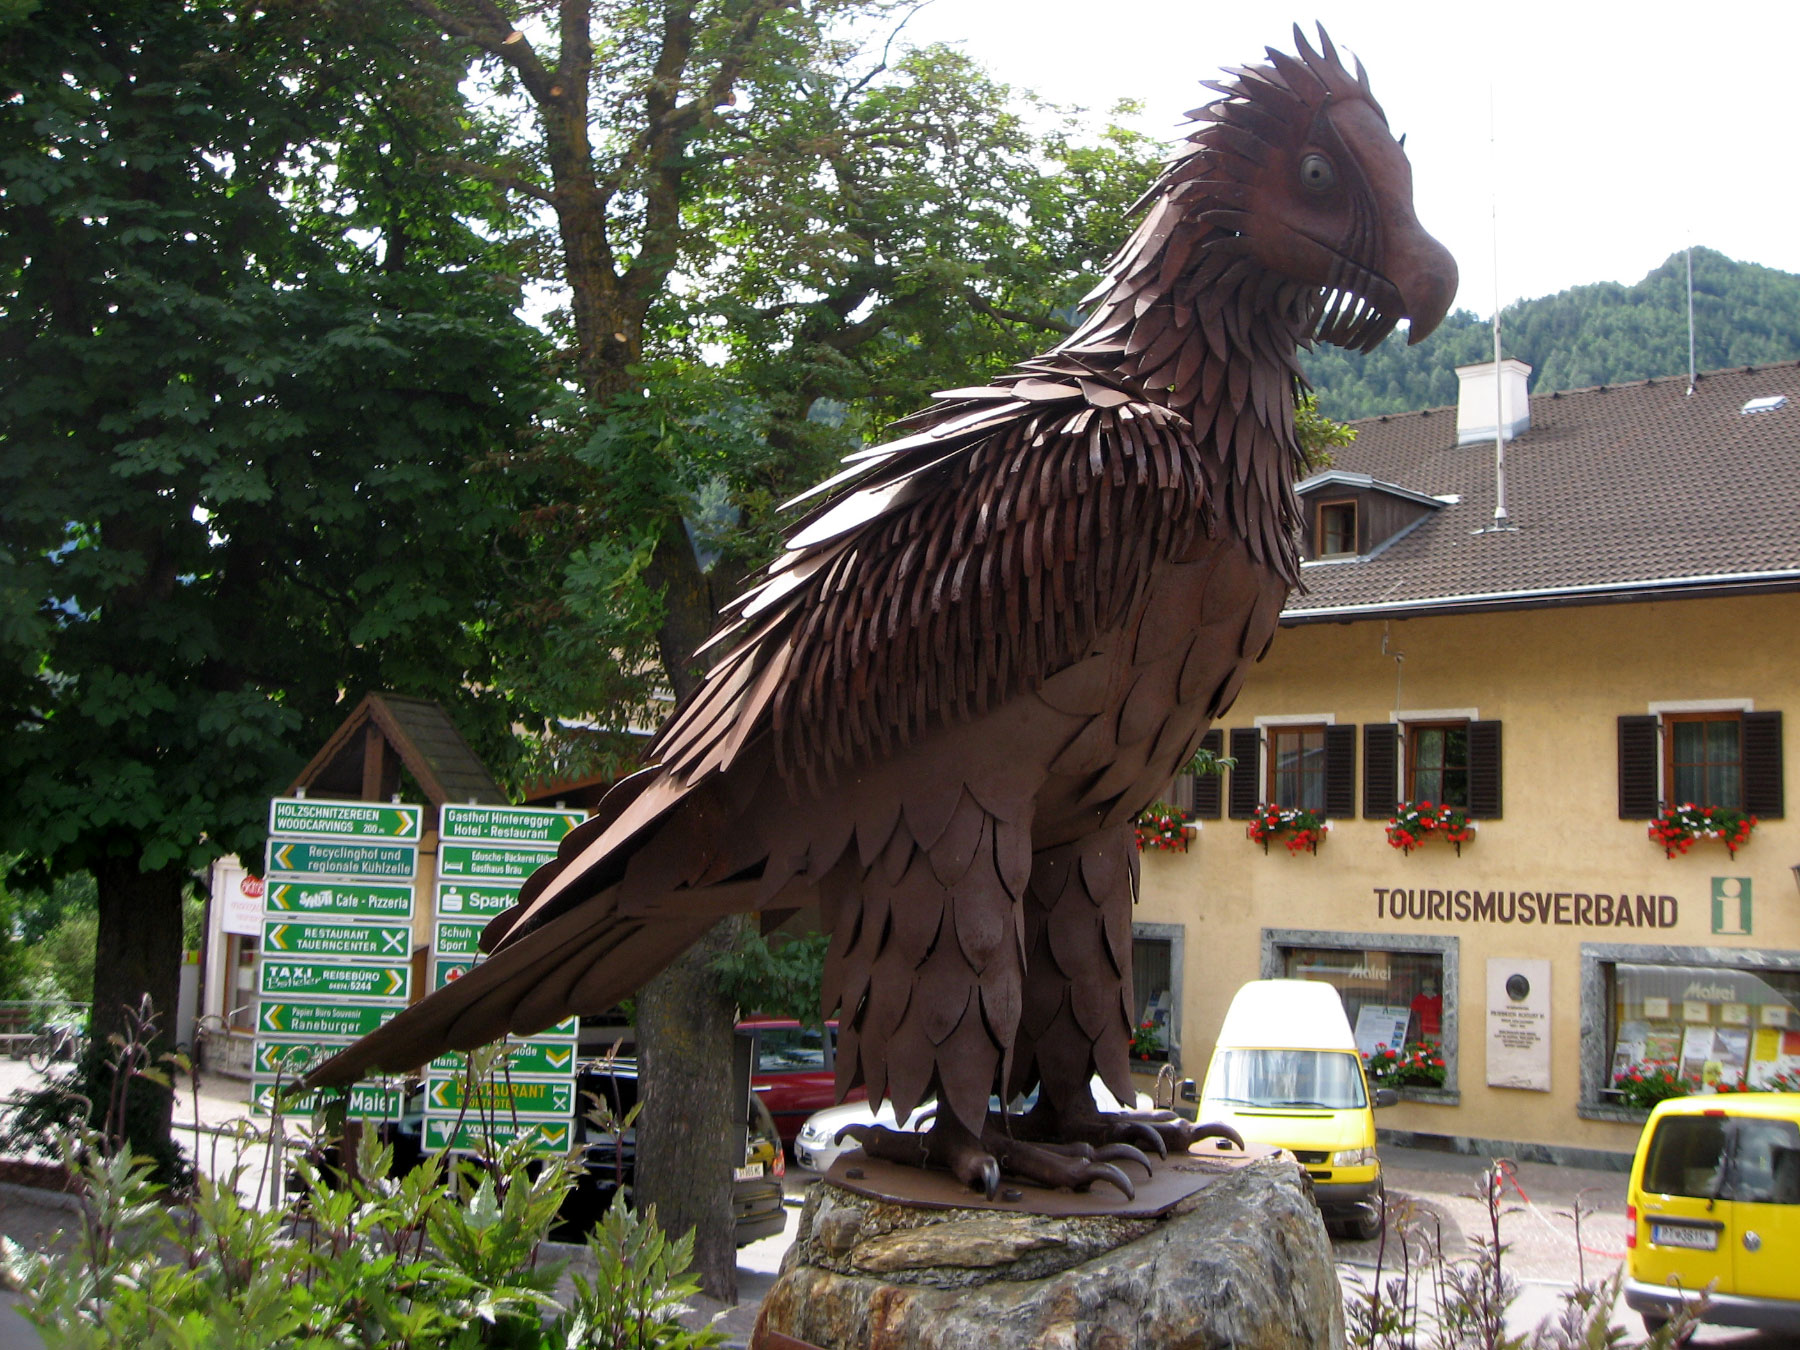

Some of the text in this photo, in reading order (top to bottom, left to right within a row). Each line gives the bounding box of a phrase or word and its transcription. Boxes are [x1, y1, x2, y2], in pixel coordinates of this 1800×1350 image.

[277, 804, 380, 821] HOLZSCHNITZEREIEN
[448, 810, 555, 828] Gasthof Hinteregger
[277, 818, 354, 833] WOODCARVINGS
[362, 823, 378, 834] 200
[453, 824, 482, 836] Hotel
[490, 826, 549, 840] Restaurant
[308, 845, 401, 861] Recyclinghof und
[307, 860, 411, 875] regionale Kühlzelle
[471, 863, 504, 874] Gasthaus
[368, 895, 409, 909] Pizzeria
[1373, 888, 1679, 929] TOURISMUSVERBAND
[304, 927, 370, 940] RESTAURANT
[440, 926, 472, 938] Schuh
[296, 939, 377, 952] TAUERNCENTER
[440, 939, 467, 952] Sport
[269, 966, 380, 982] TAXI REISEBÜRO
[291, 1007, 361, 1019] Papier Büro Souvenir
[291, 1019, 361, 1034] Raneburger
[350, 1091, 396, 1112] Maier
[456, 1097, 518, 1110] SORTHOTE
